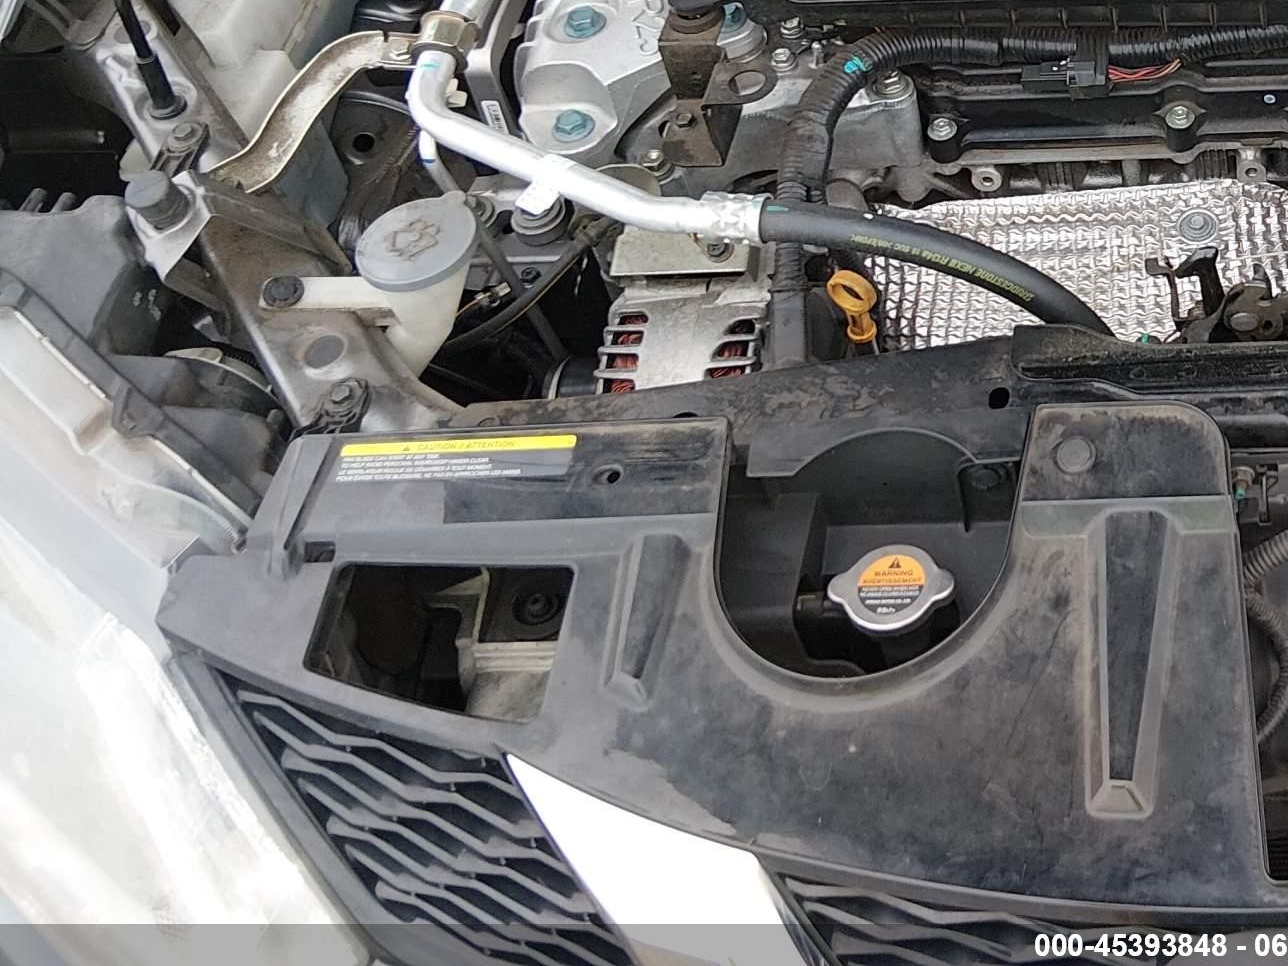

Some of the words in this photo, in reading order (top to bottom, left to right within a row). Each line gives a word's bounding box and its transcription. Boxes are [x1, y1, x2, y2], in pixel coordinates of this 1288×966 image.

[418, 443, 456, 451] CAUTION
[465, 441, 515, 450] ATTENTION
[874, 569, 914, 577] WARNING
[863, 576, 923, 584] AVERTISSEMENT
